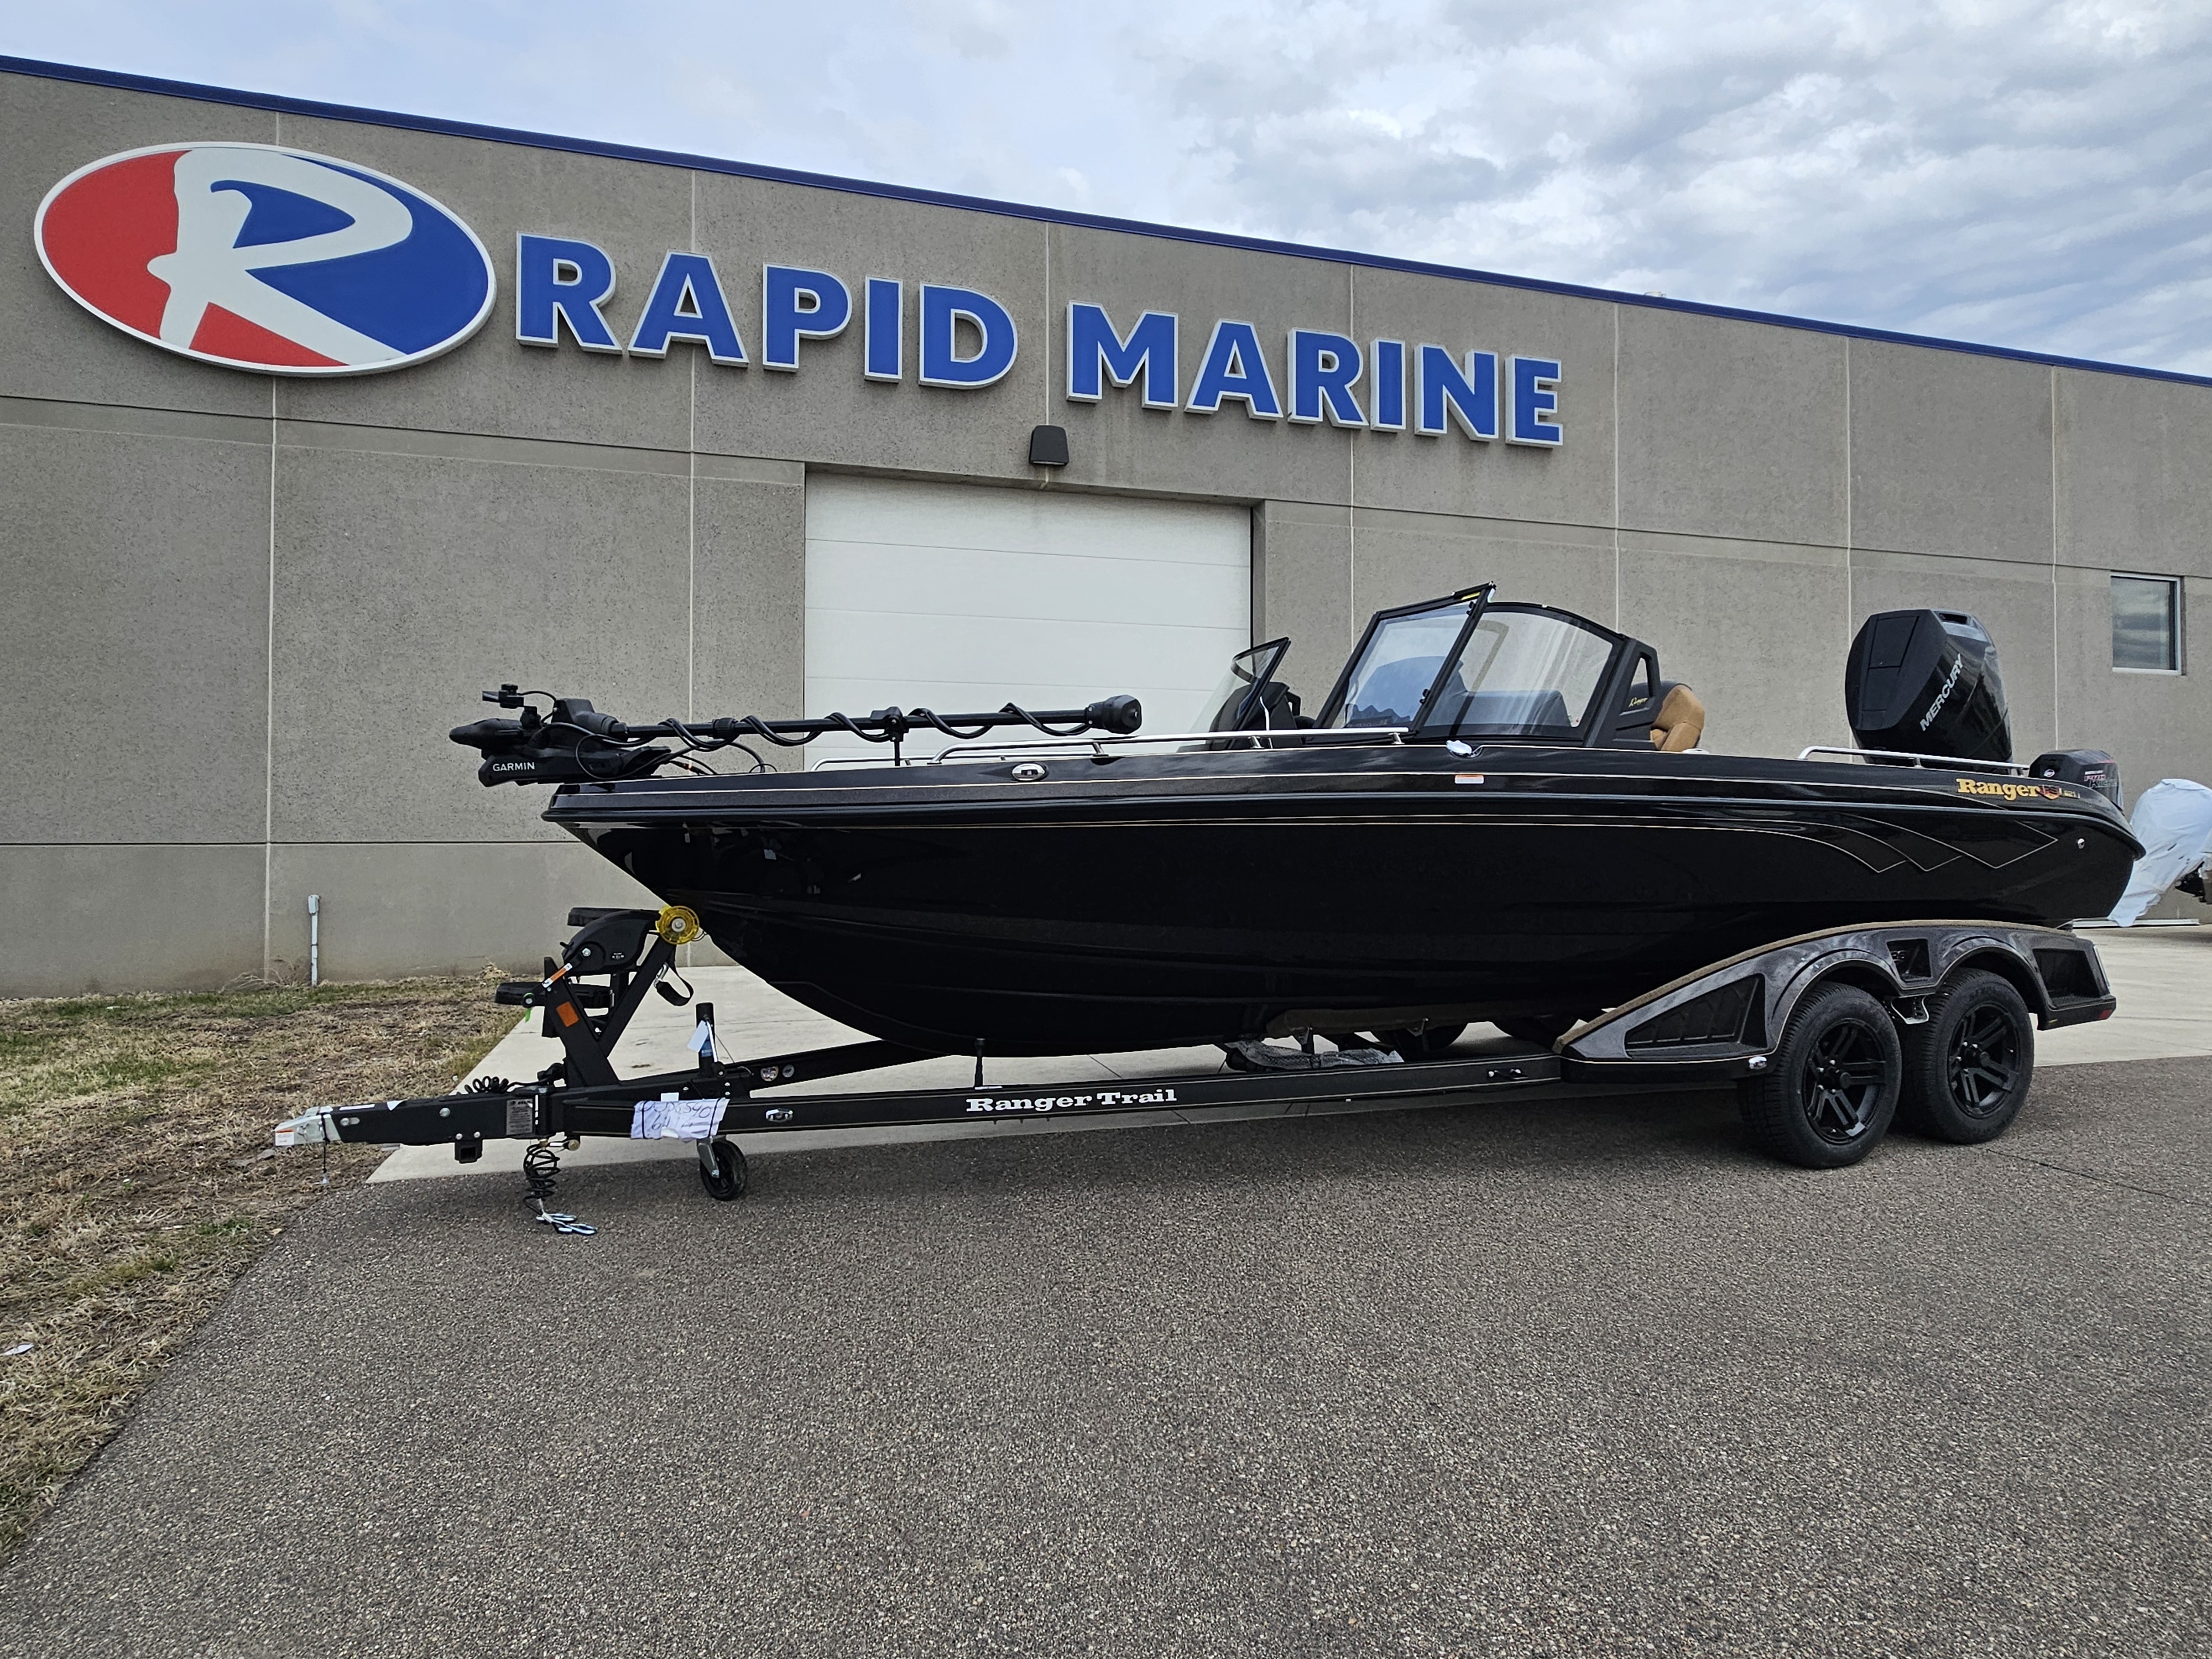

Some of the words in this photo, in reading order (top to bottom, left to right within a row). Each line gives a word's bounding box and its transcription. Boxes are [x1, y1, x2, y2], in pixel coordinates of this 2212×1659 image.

[516, 230, 1018, 390] RAPID
[1066, 299, 1564, 448] MARINE
[1919, 653, 1963, 732] MERCURY
[492, 761, 535, 772] GARMIN
[1956, 778, 2041, 801] Ranger
[966, 1095, 1093, 1112] Ranger
[1097, 1089, 1177, 1105] Trail
